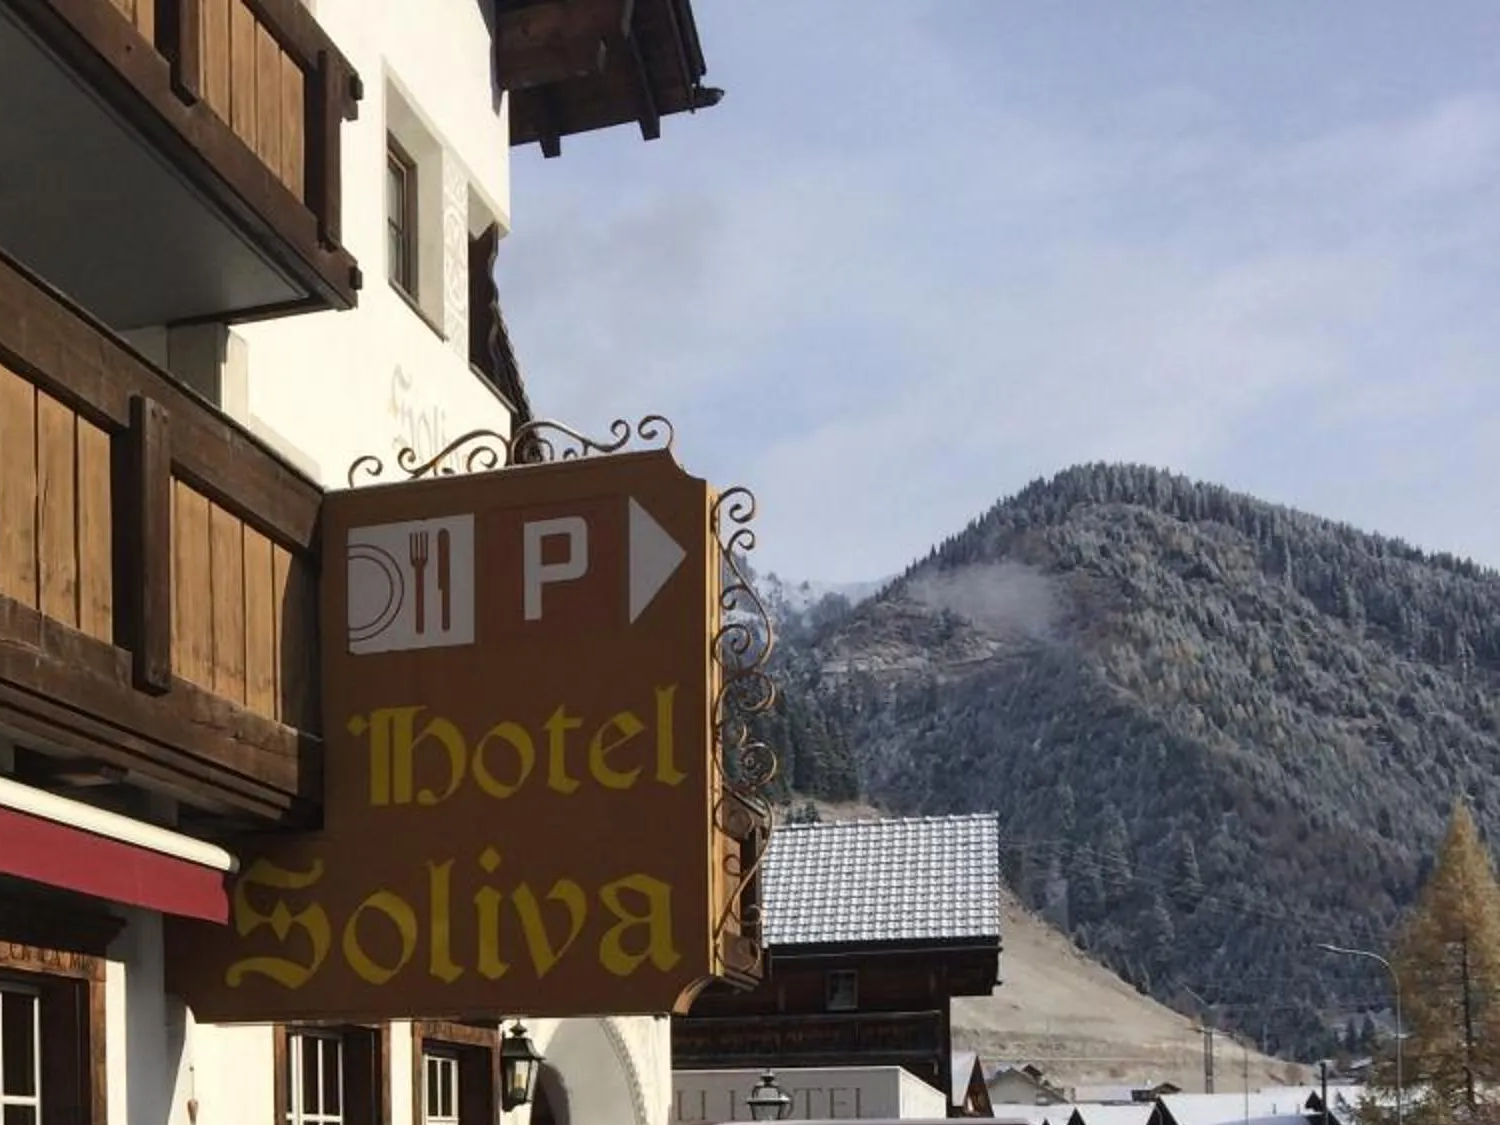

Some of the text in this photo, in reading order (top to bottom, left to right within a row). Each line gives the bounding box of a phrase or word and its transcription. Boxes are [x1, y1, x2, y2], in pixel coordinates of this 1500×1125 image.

[523, 516, 589, 621] P
[346, 684, 689, 806] Hotel
[225, 845, 683, 989] Soliva
